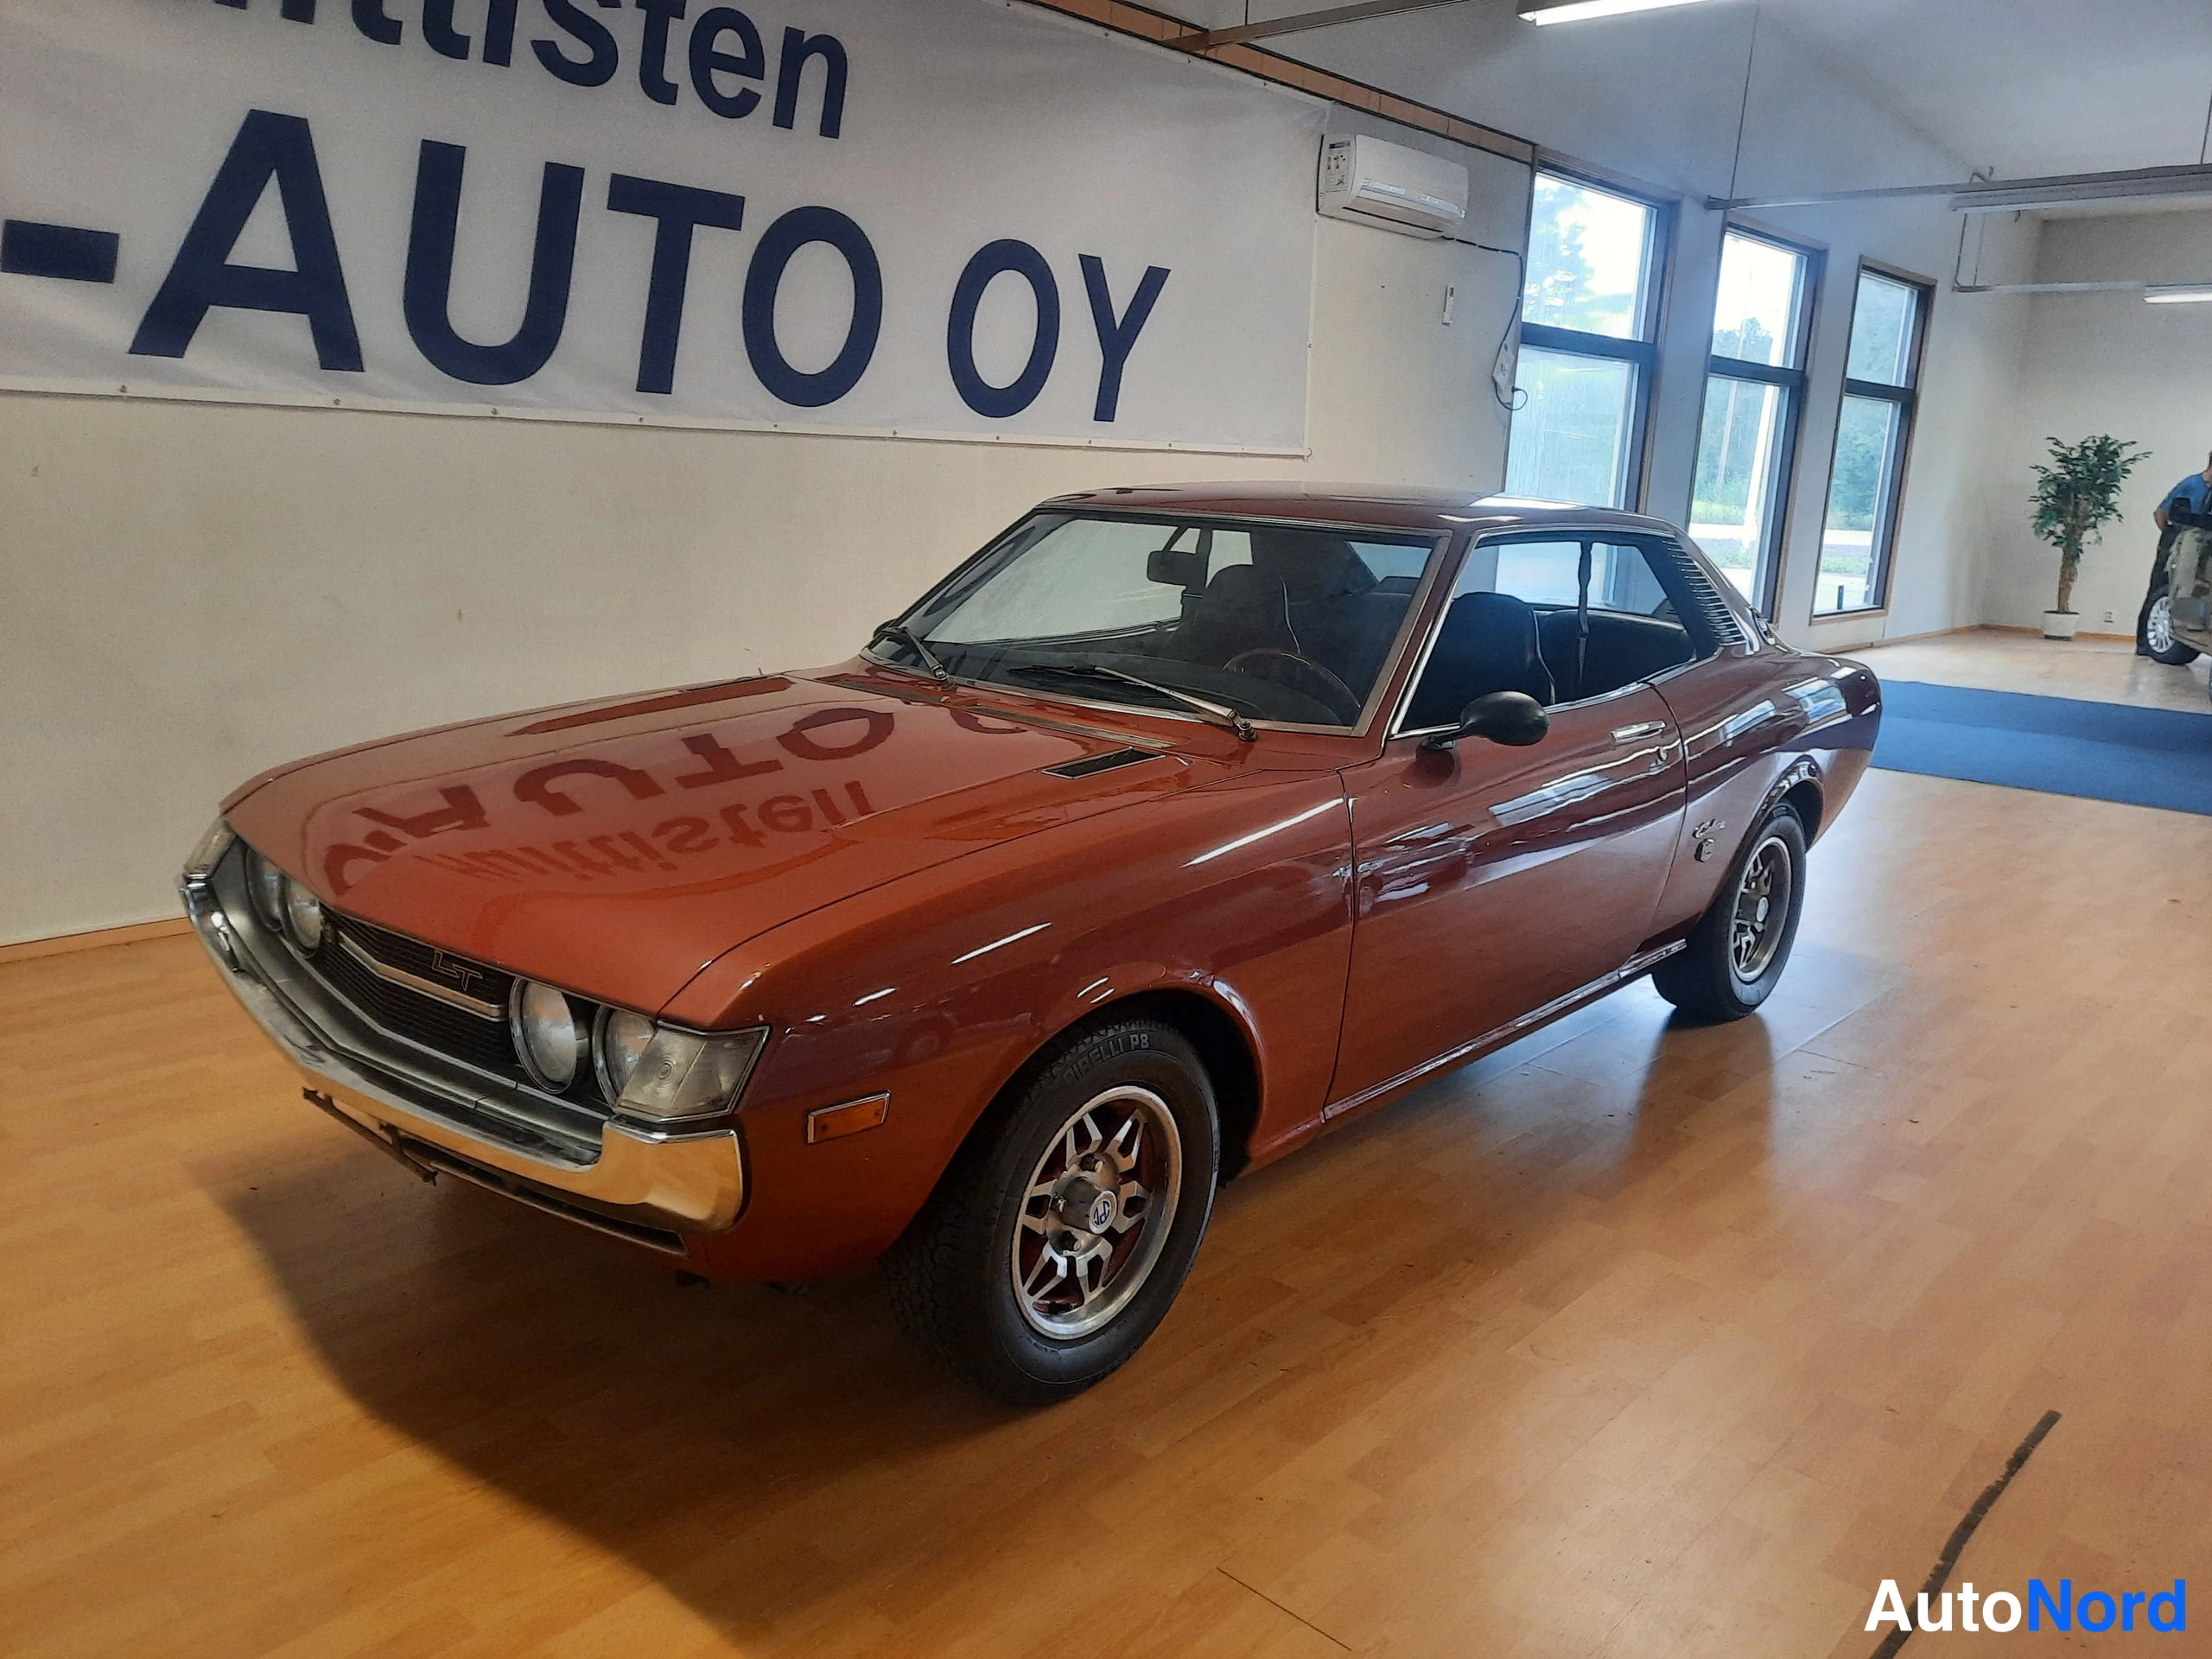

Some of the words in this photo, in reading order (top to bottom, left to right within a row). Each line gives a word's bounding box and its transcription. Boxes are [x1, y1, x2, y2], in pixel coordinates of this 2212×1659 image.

[947, 238, 1172, 423] OY
[431, 949, 484, 992] LT
[1062, 1036, 1124, 1085] PIRELLI
[1129, 1033, 1150, 1051] P8
